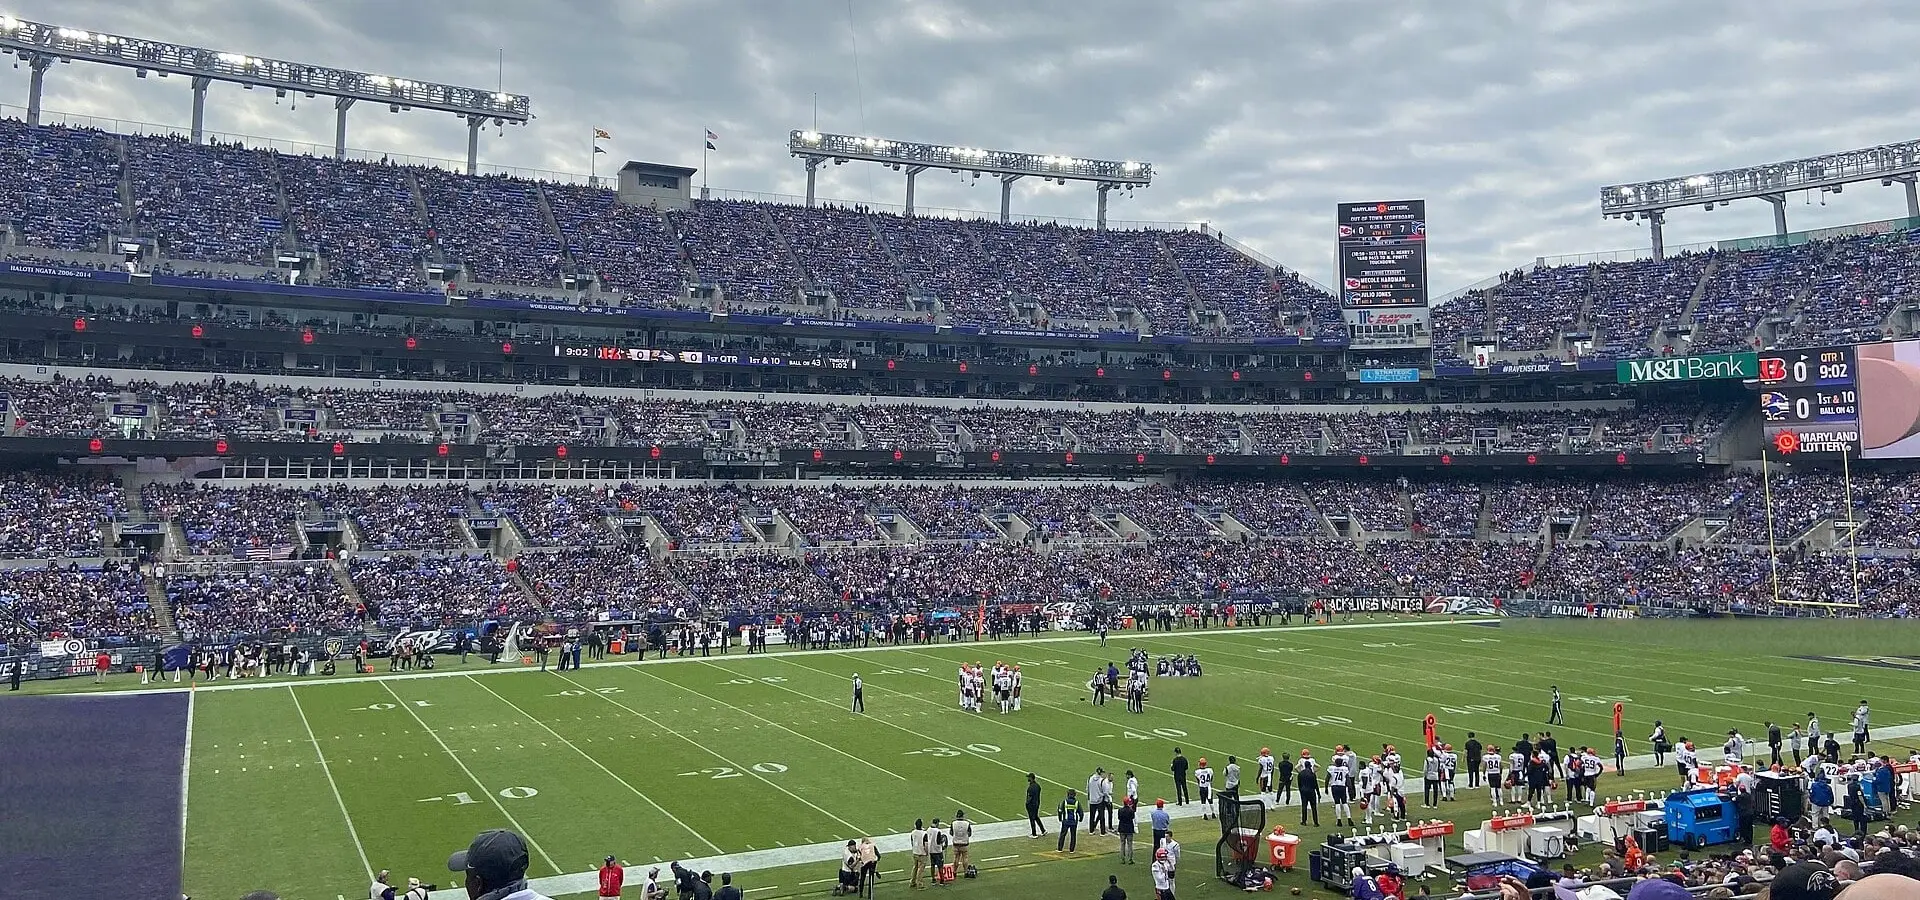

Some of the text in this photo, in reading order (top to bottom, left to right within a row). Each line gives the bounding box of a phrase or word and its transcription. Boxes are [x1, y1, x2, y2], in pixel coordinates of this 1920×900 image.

[1358, 226, 1364, 235] 0
[1400, 225, 1405, 233] 7
[10, 264, 92, 279] HALOTI NGATA 2006-2014
[547, 304, 576, 312] CHAMPIONS
[565, 347, 589, 357] 9:02
[635, 351, 645, 360] 0
[690, 353, 699, 363] 0
[720, 354, 738, 364] QTR
[762, 357, 770, 365] &
[770, 356, 781, 366] 10
[789, 359, 802, 367] BALL
[811, 358, 822, 368] 43
[1819, 352, 1845, 364] QTR 1
[832, 361, 848, 370] 1:02
[1502, 364, 1550, 373] #RAVENSFLOCK
[1629, 356, 1745, 383] M&T Bank
[1793, 361, 1807, 384] 0
[1819, 363, 1848, 380] 9:02
[1816, 390, 1855, 406] 1ST & 10
[1796, 397, 1810, 419] 0
[1819, 405, 1856, 416] BALL ON 43
[1800, 430, 1858, 444] MARYLAND
[1551, 605, 1635, 620] BALTIMOE RAVENS
[1282, 715, 1353, 727] 50
[1123, 728, 1188, 742] 40
[922, 742, 1003, 758] 30
[1445, 757, 1455, 768] 25
[1487, 760, 1498, 770] 84
[1584, 758, 1595, 769] 59
[700, 761, 790, 780] 20
[1333, 770, 1343, 781] 74
[1825, 766, 1837, 776] 22
[1199, 774, 1211, 784] 34
[446, 785, 539, 806] 10
[1794, 831, 1801, 841] 9
[1273, 845, 1286, 860] G
[1367, 879, 1377, 891] 8
